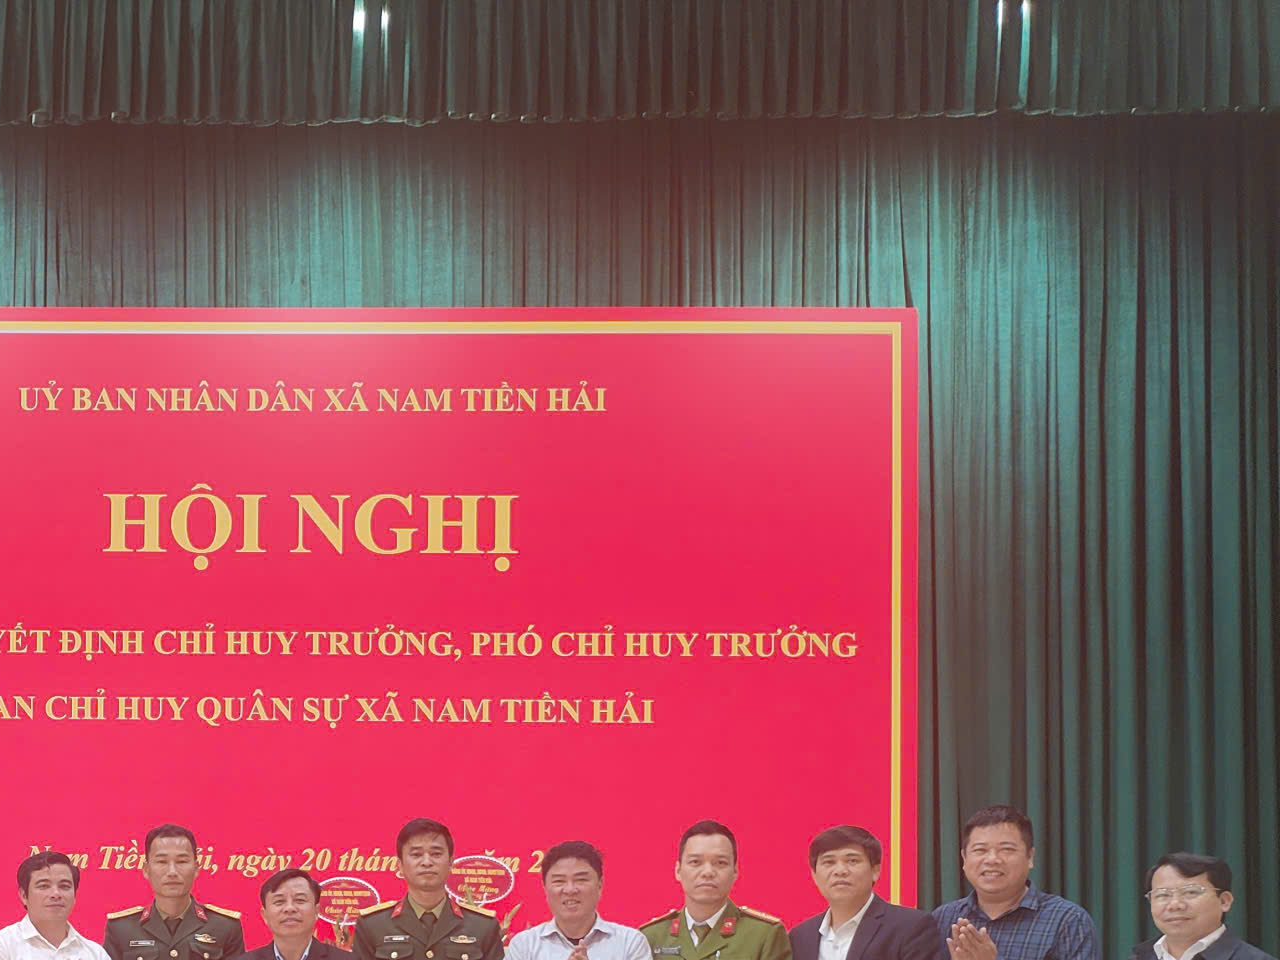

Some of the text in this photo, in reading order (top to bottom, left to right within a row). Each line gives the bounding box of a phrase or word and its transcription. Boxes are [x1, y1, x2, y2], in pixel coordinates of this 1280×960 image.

[19, 380, 607, 412] UỶ BAN NHÂN DÂN XÃ NAM TIỀN HẢI
[102, 483, 519, 572] HỘI NGHỊ
[59, 630, 145, 661] ĐỊNH
[153, 623, 216, 655] CHỈ
[225, 631, 298, 655] HUY
[306, 624, 462, 661] TRƯỞNG,
[471, 624, 543, 656] PHÓ
[551, 625, 615, 657] CHỈ
[624, 633, 699, 657] HUY
[706, 624, 858, 658] TRƯỞNG
[45, 688, 106, 720] CHỈ
[116, 697, 189, 721] HUY
[197, 689, 293, 726] QUÂN
[303, 694, 349, 729] SỰ
[356, 691, 404, 722] XÃ
[412, 698, 493, 723] NAM
[500, 692, 582, 724] TIỀN
[591, 692, 655, 724] HẢI
[227, 847, 291, 878] ngày
[300, 848, 332, 870] 20
